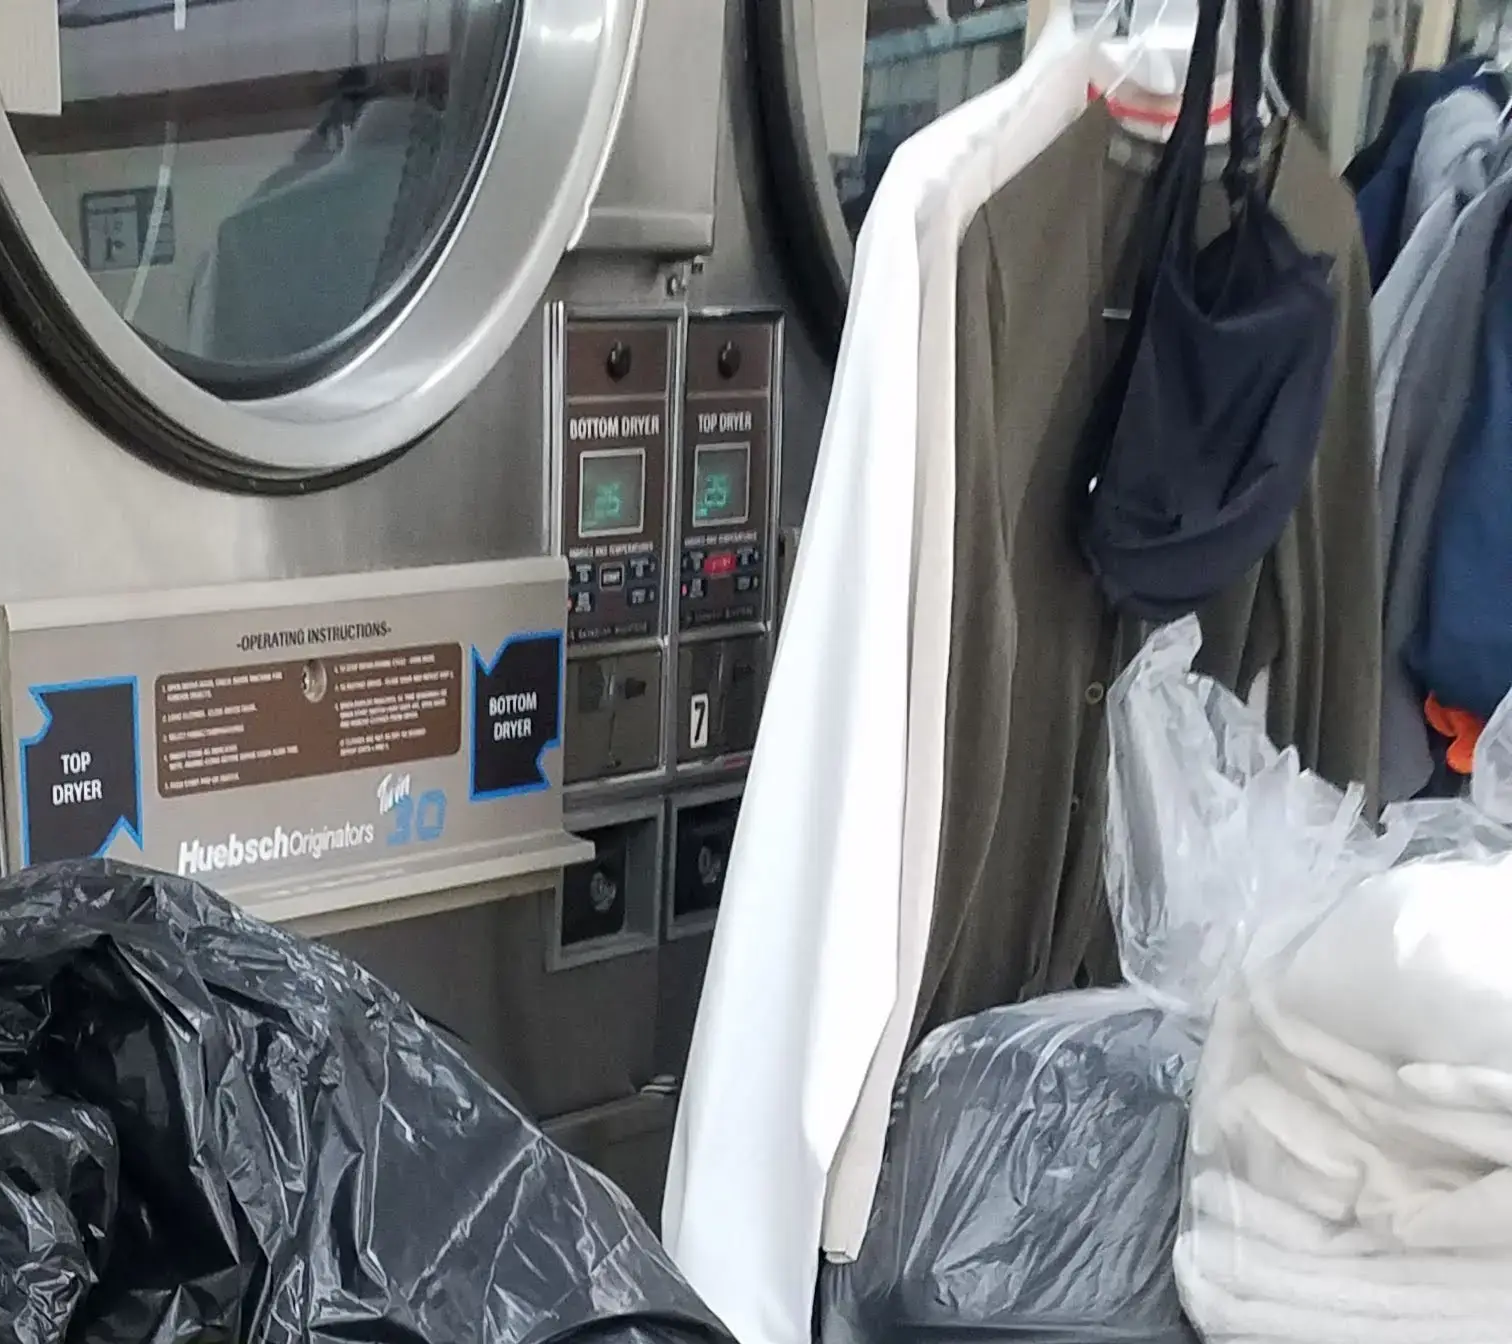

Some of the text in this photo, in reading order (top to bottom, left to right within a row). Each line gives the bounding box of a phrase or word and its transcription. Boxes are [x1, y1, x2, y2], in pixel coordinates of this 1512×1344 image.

[569, 414, 659, 440] BOTTOM DRYER
[698, 411, 752, 433] TOP DRYER
[489, 691, 537, 716] BOTTOM
[493, 717, 532, 741] DRYER
[695, 702, 705, 743] 7
[60, 751, 91, 774] TOP
[52, 779, 102, 805] DRYER
